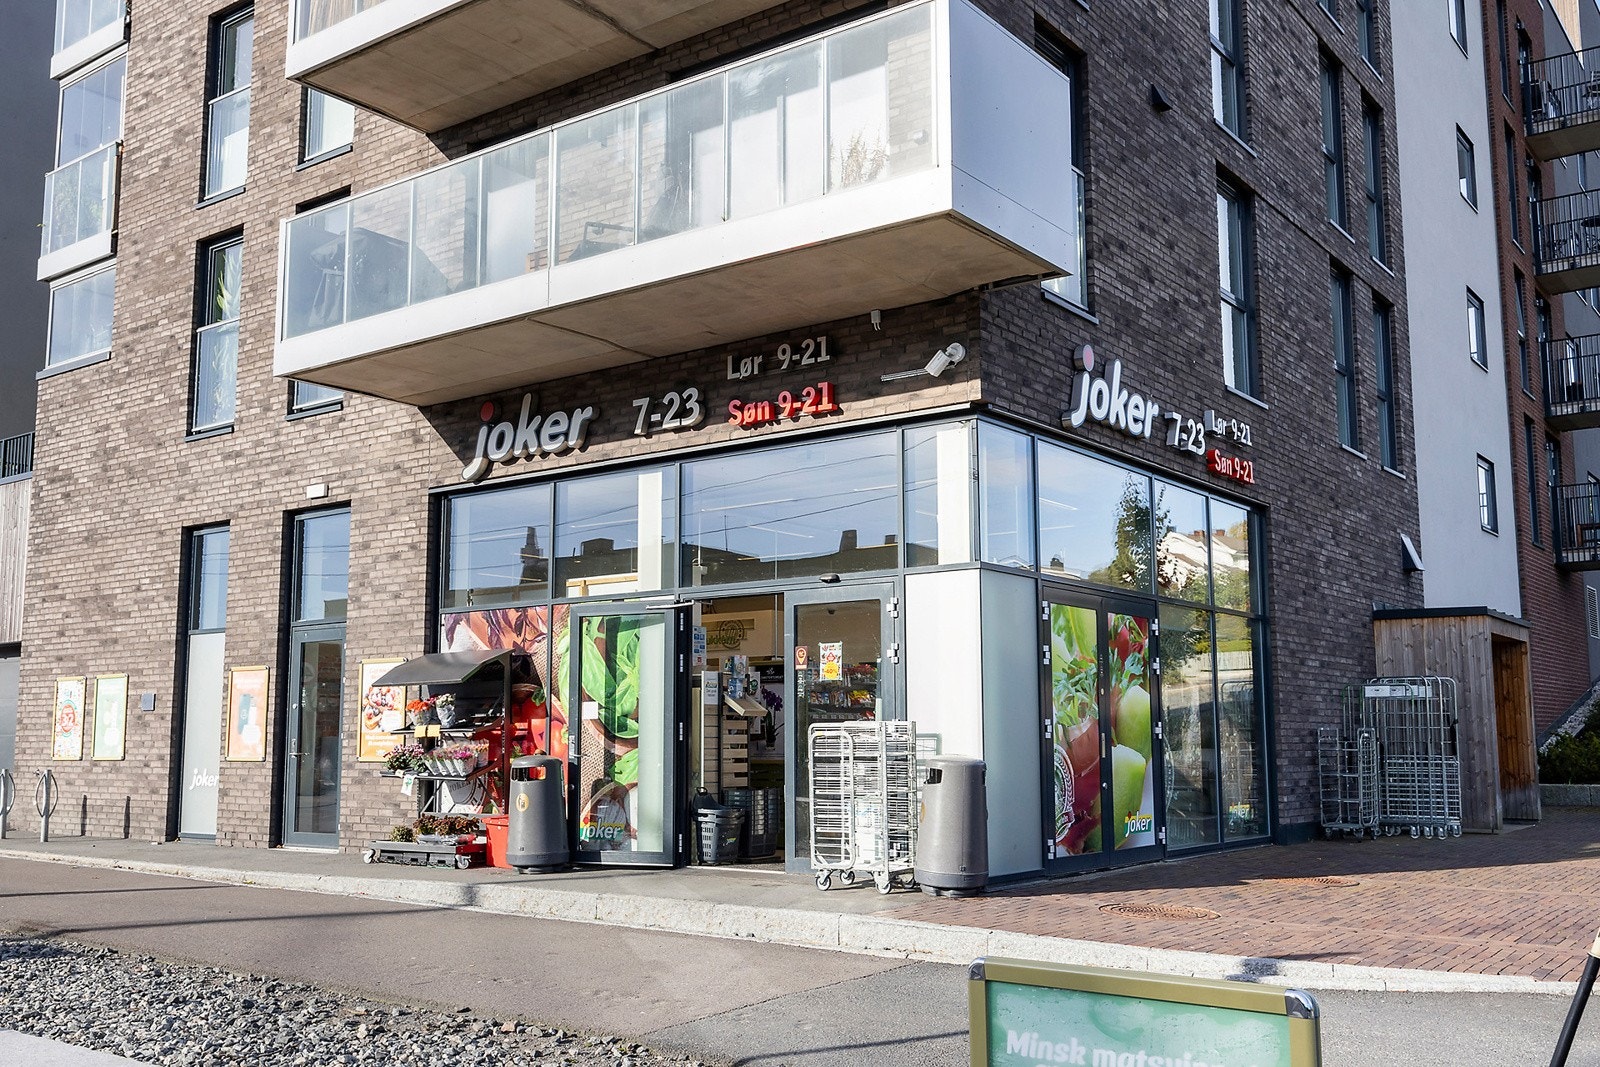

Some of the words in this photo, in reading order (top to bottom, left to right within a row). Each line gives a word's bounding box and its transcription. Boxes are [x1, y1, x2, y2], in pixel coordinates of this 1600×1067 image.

[727, 354, 763, 380] Lør
[777, 336, 831, 370] 9-21
[632, 387, 703, 435] 7-23
[728, 399, 774, 426] Søn
[777, 381, 836, 418] 9-21
[1067, 344, 1159, 439] joker
[462, 392, 593, 481] joker
[1167, 411, 1206, 456] 7-23
[1208, 410, 1227, 436] Lør
[1231, 418, 1253, 446] 9-21
[1213, 449, 1232, 476] Søn
[1234, 457, 1255, 484] 9-21
[580, 817, 621, 841] joker
[1125, 810, 1151, 838] joker
[1006, 1030, 1086, 1065] Minsk
[1092, 1048, 1226, 1067] matsvi
